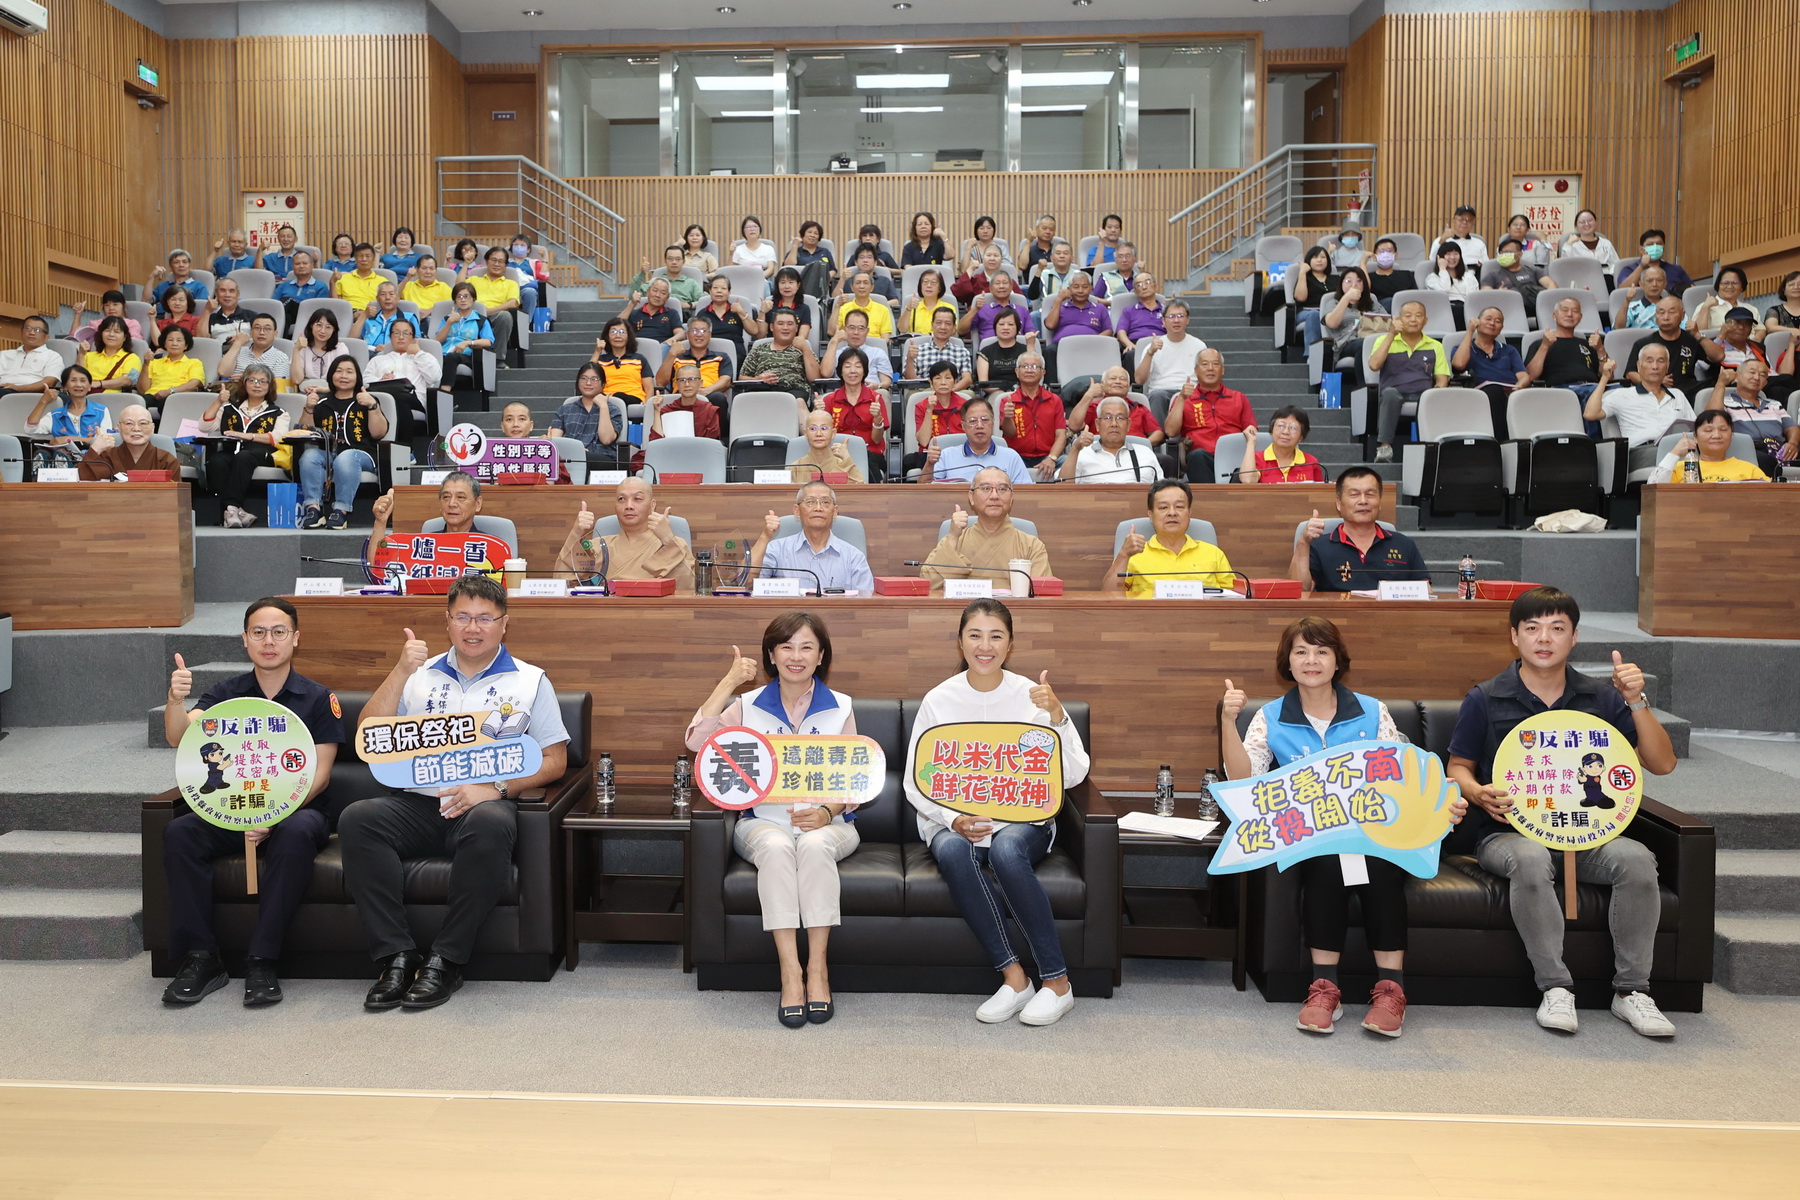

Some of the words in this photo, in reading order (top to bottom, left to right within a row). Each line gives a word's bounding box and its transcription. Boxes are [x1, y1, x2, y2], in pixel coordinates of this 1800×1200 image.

[492, 443, 552, 458] 性別平等
[386, 537, 487, 563] 一爐一香
[438, 683, 451, 714] 環境保
[221, 715, 287, 736] 反詐騙
[364, 716, 477, 754] 環保祭祀
[241, 739, 270, 752] 收取
[1539, 730, 1610, 748] 反詐騙
[234, 752, 278, 766] 提款卡
[285, 753, 303, 769] 詐
[413, 744, 526, 785] 節能減碳
[782, 745, 870, 766] 遠離毒品
[932, 739, 1050, 773] 以米代金
[1524, 754, 1553, 767] 要求
[235, 765, 279, 779] 及密碼
[709, 741, 761, 796] 毒
[1504, 769, 1575, 782] 去ATM解除
[1612, 769, 1632, 787] 詐
[243, 779, 271, 792] 即是
[781, 771, 870, 792] 珍惜生命
[930, 771, 1050, 807] 鮮花敬神
[1251, 746, 1402, 816] 拒毒不南
[1508, 783, 1573, 796] 分期付款
[1526, 797, 1557, 810] 即是
[1236, 788, 1388, 853] 從投開始
[1507, 802, 1617, 845] 投縣政府警察局南投分局
